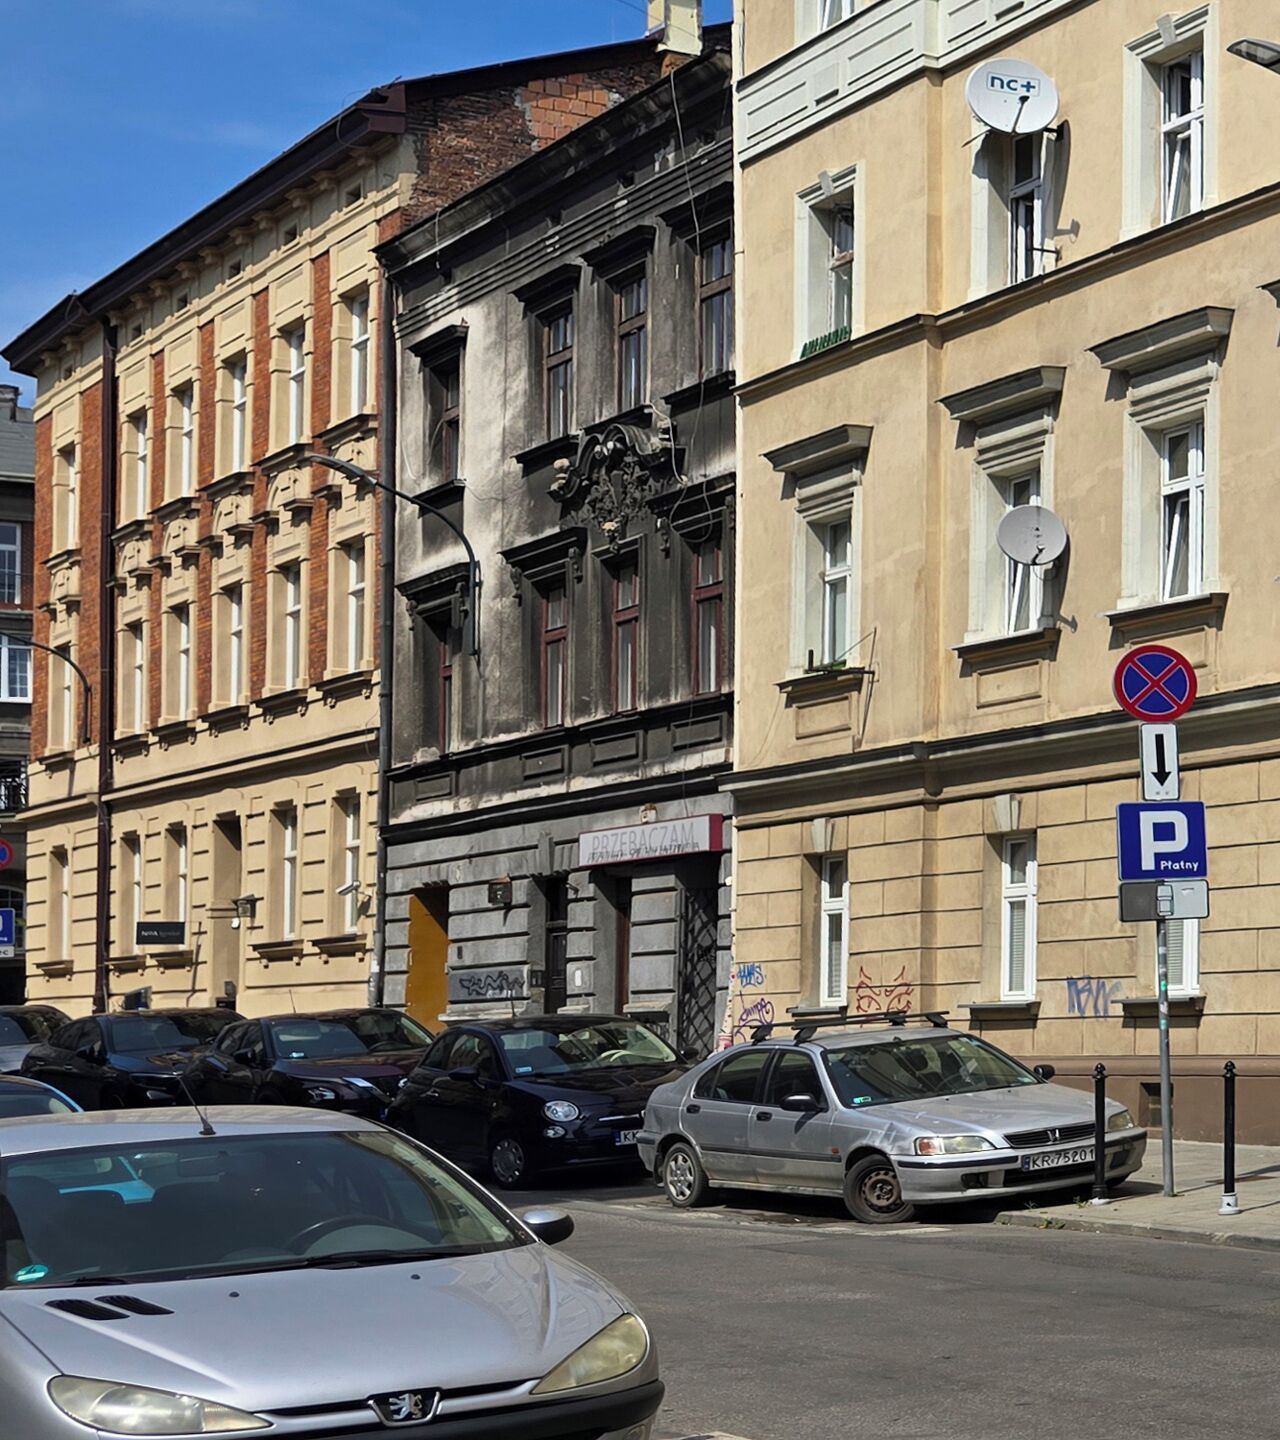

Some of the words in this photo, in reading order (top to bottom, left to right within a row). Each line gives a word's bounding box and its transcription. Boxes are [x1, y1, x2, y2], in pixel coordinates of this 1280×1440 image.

[990, 75, 1036, 93] nc+
[592, 822, 696, 853] PRZEBACZAM
[1139, 810, 1189, 871] P
[1160, 860, 1200, 872] Płatny
[1055, 1148, 1095, 1165] 75201
